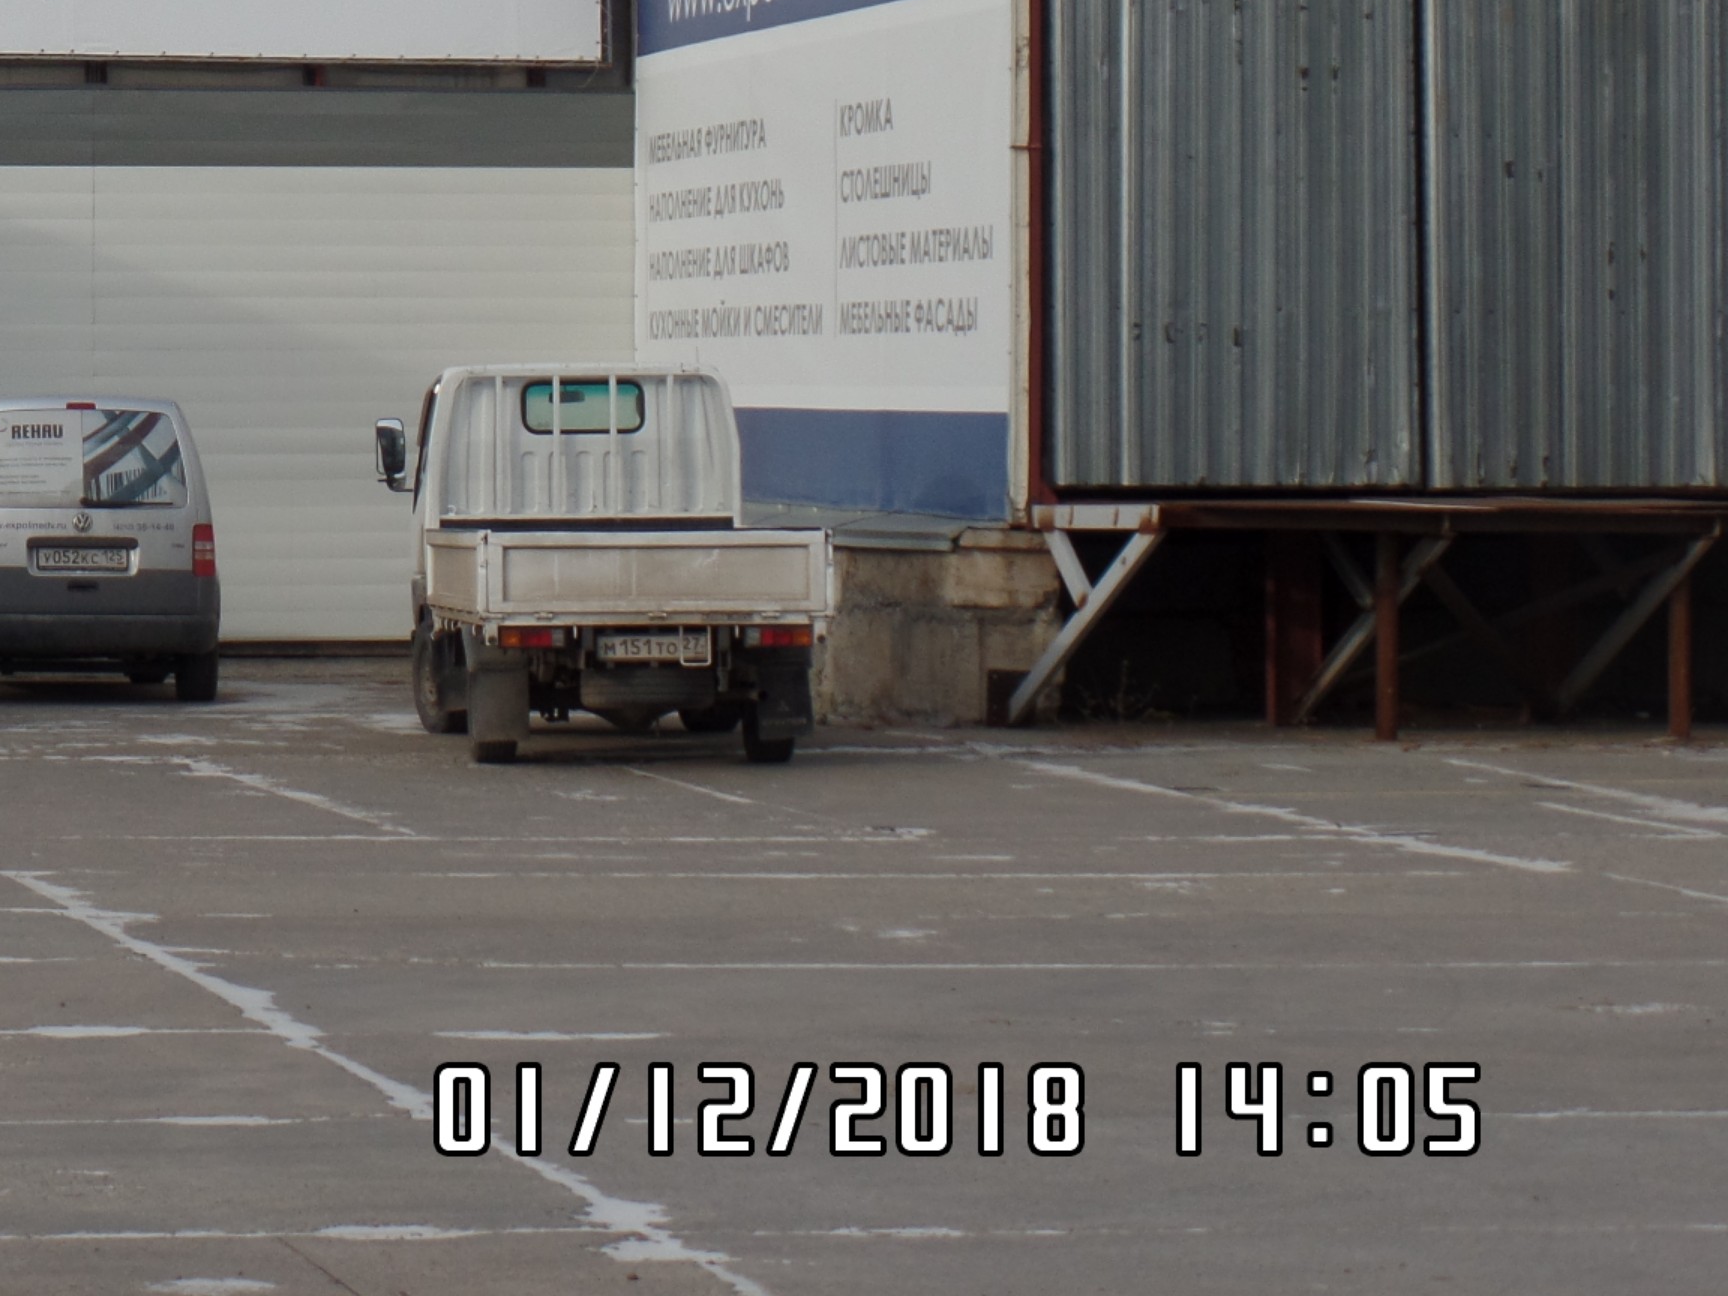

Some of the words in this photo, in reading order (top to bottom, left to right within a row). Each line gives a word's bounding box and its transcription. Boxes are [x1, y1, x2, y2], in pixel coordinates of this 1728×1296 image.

[840, 99, 893, 136] КРОМКА
[649, 128, 702, 163] МЕБЕЛЬНАЯ
[705, 119, 766, 154] ФУРНИТУРА
[649, 186, 712, 221] НАПОЛНЕНИЕ
[714, 184, 736, 219] ДЛЯ
[739, 179, 785, 212] КУХОНЬ
[841, 161, 931, 203] СТОЛЕШНИЦЫ
[649, 247, 711, 280] НАПОЛНЕНИЕ
[713, 246, 736, 280] ДЛЯ
[739, 241, 789, 275] ШКАФОВ
[842, 231, 906, 268] ЛИСТОВЫЕ
[910, 225, 993, 264] МАТЕРИАЛЫ
[649, 309, 699, 340] КУХОННЫЕ
[702, 300, 741, 338] МОЙКИ
[743, 306, 752, 336] И
[754, 304, 823, 336] СМЕСИТЕЛИ
[841, 300, 911, 334] МЕБЕЛЬНЫЕ
[914, 297, 978, 336] ФАСАДЫ
[11, 424, 64, 439] REHAU
